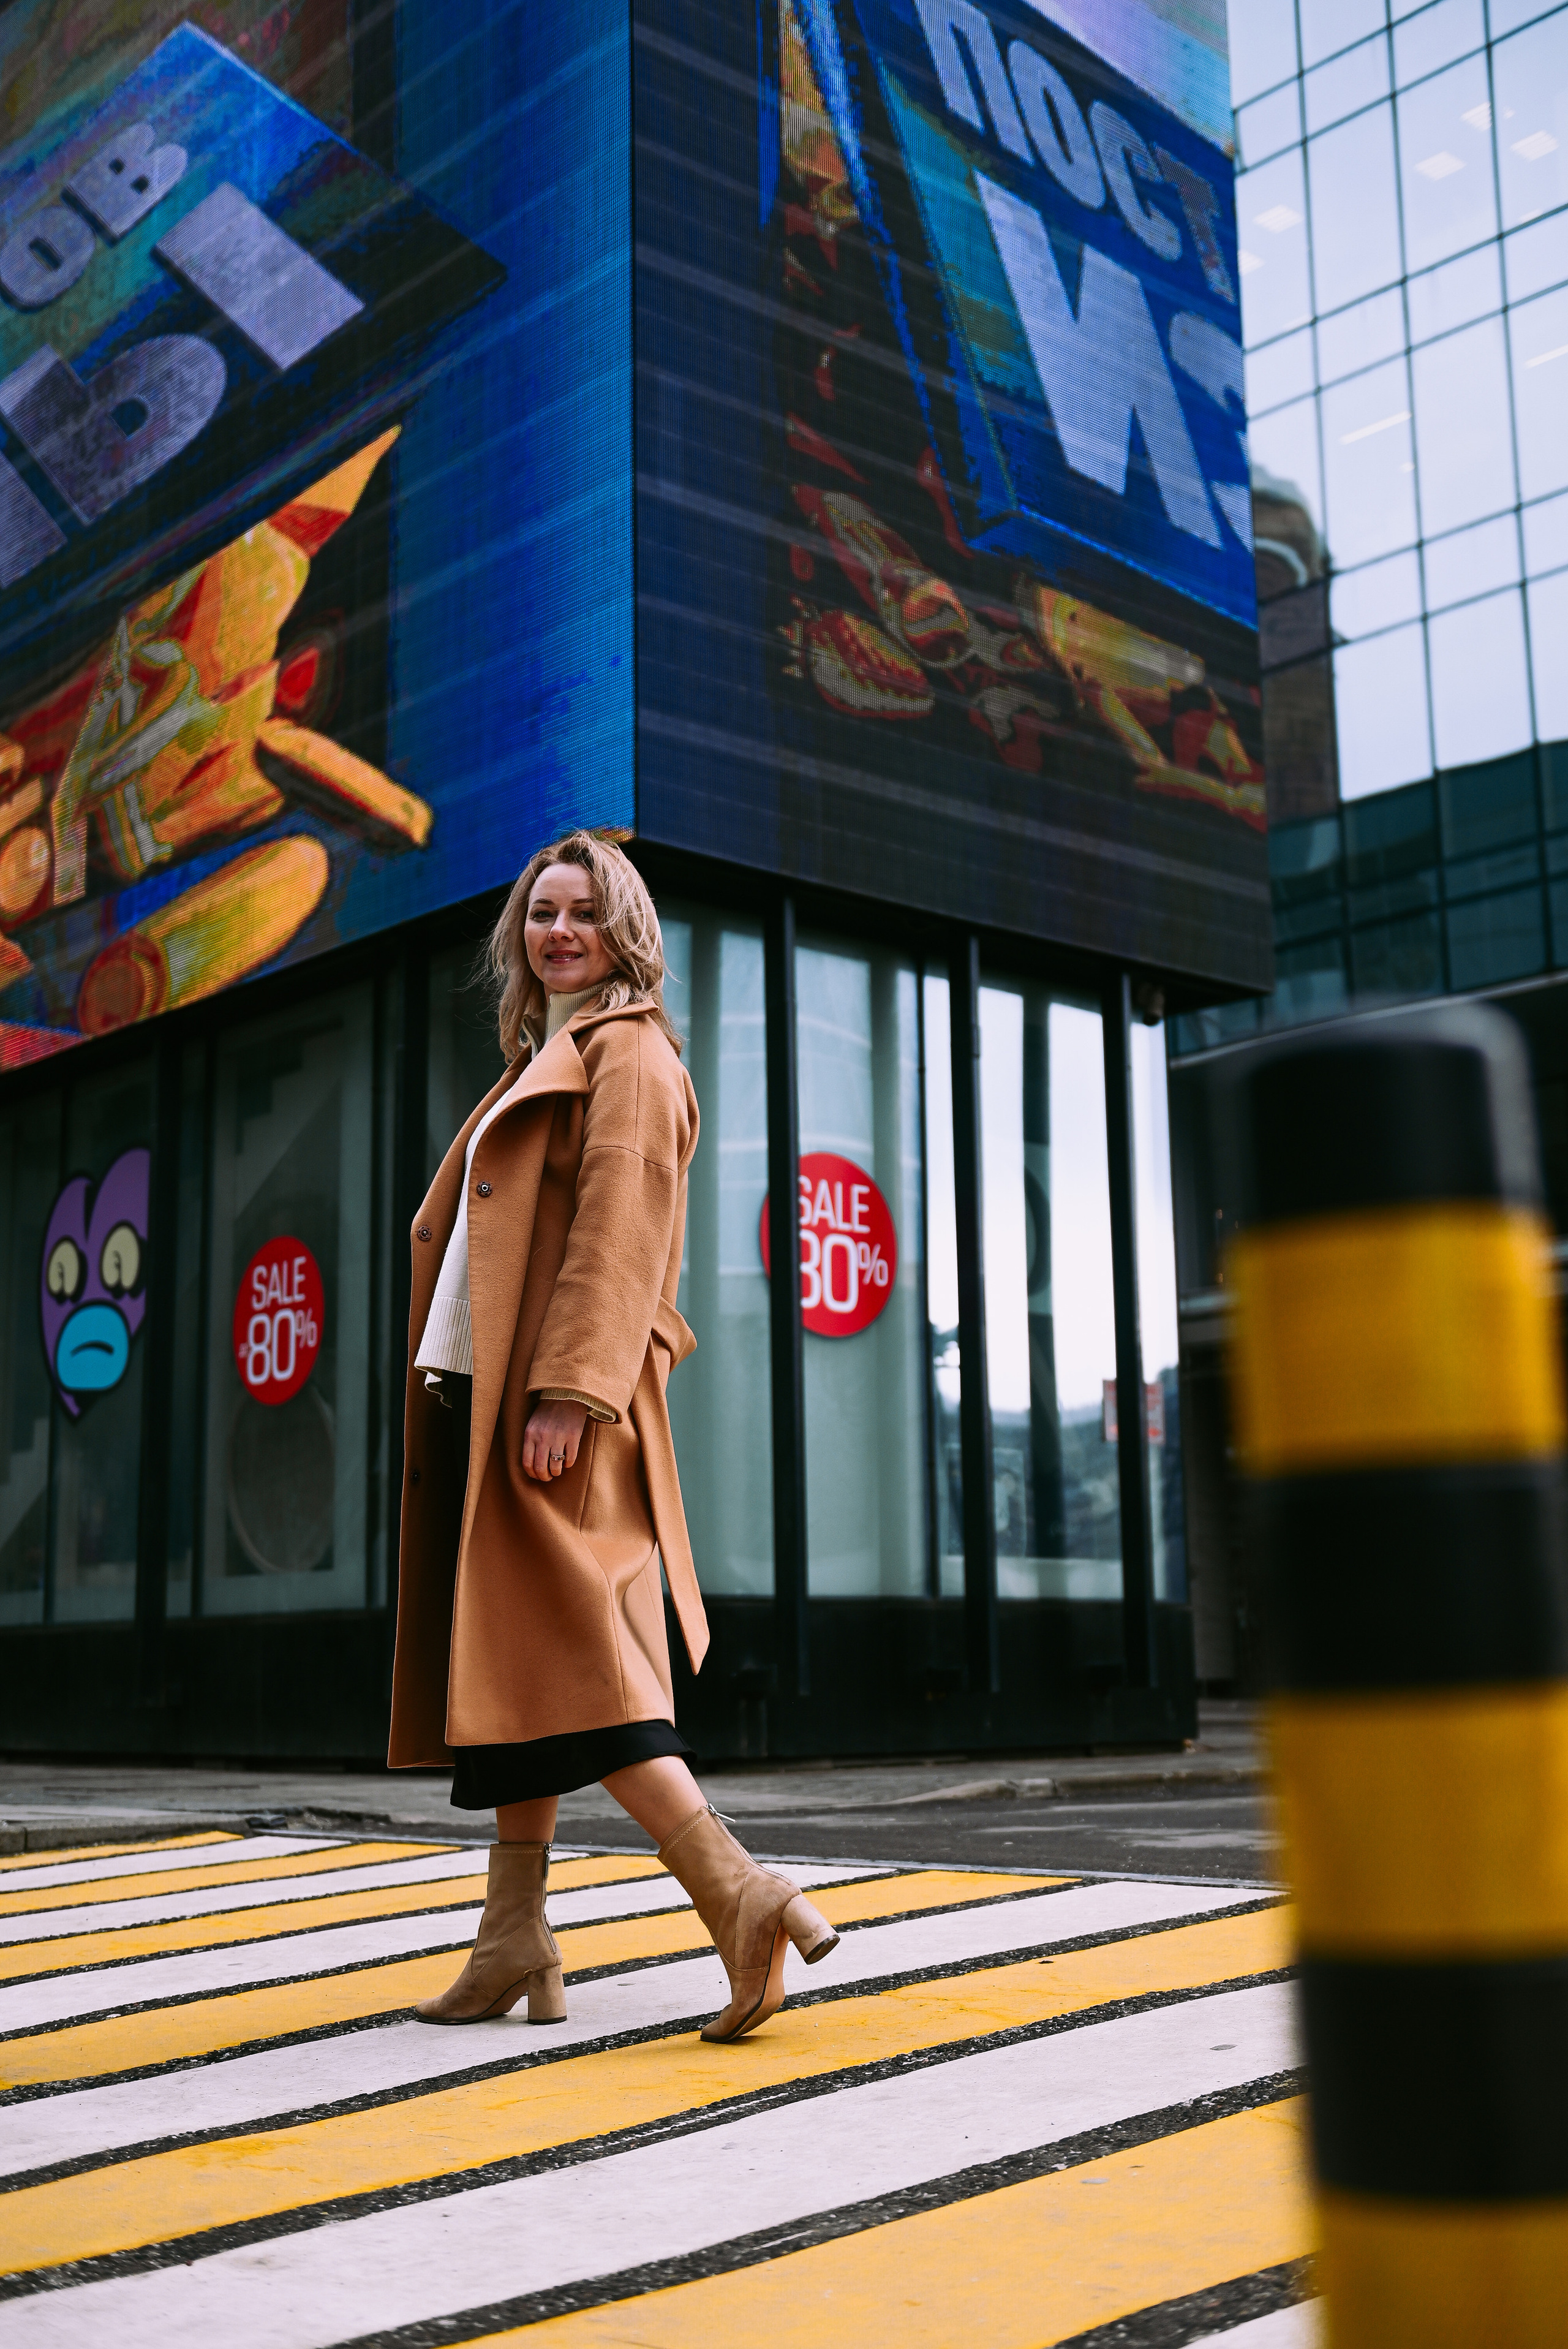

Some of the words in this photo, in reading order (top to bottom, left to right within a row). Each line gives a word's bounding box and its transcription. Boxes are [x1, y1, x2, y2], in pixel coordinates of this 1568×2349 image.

[799, 1173, 870, 1234] SALE
[252, 1255, 307, 1311] SALE
[247, 1307, 317, 1385] 80%
